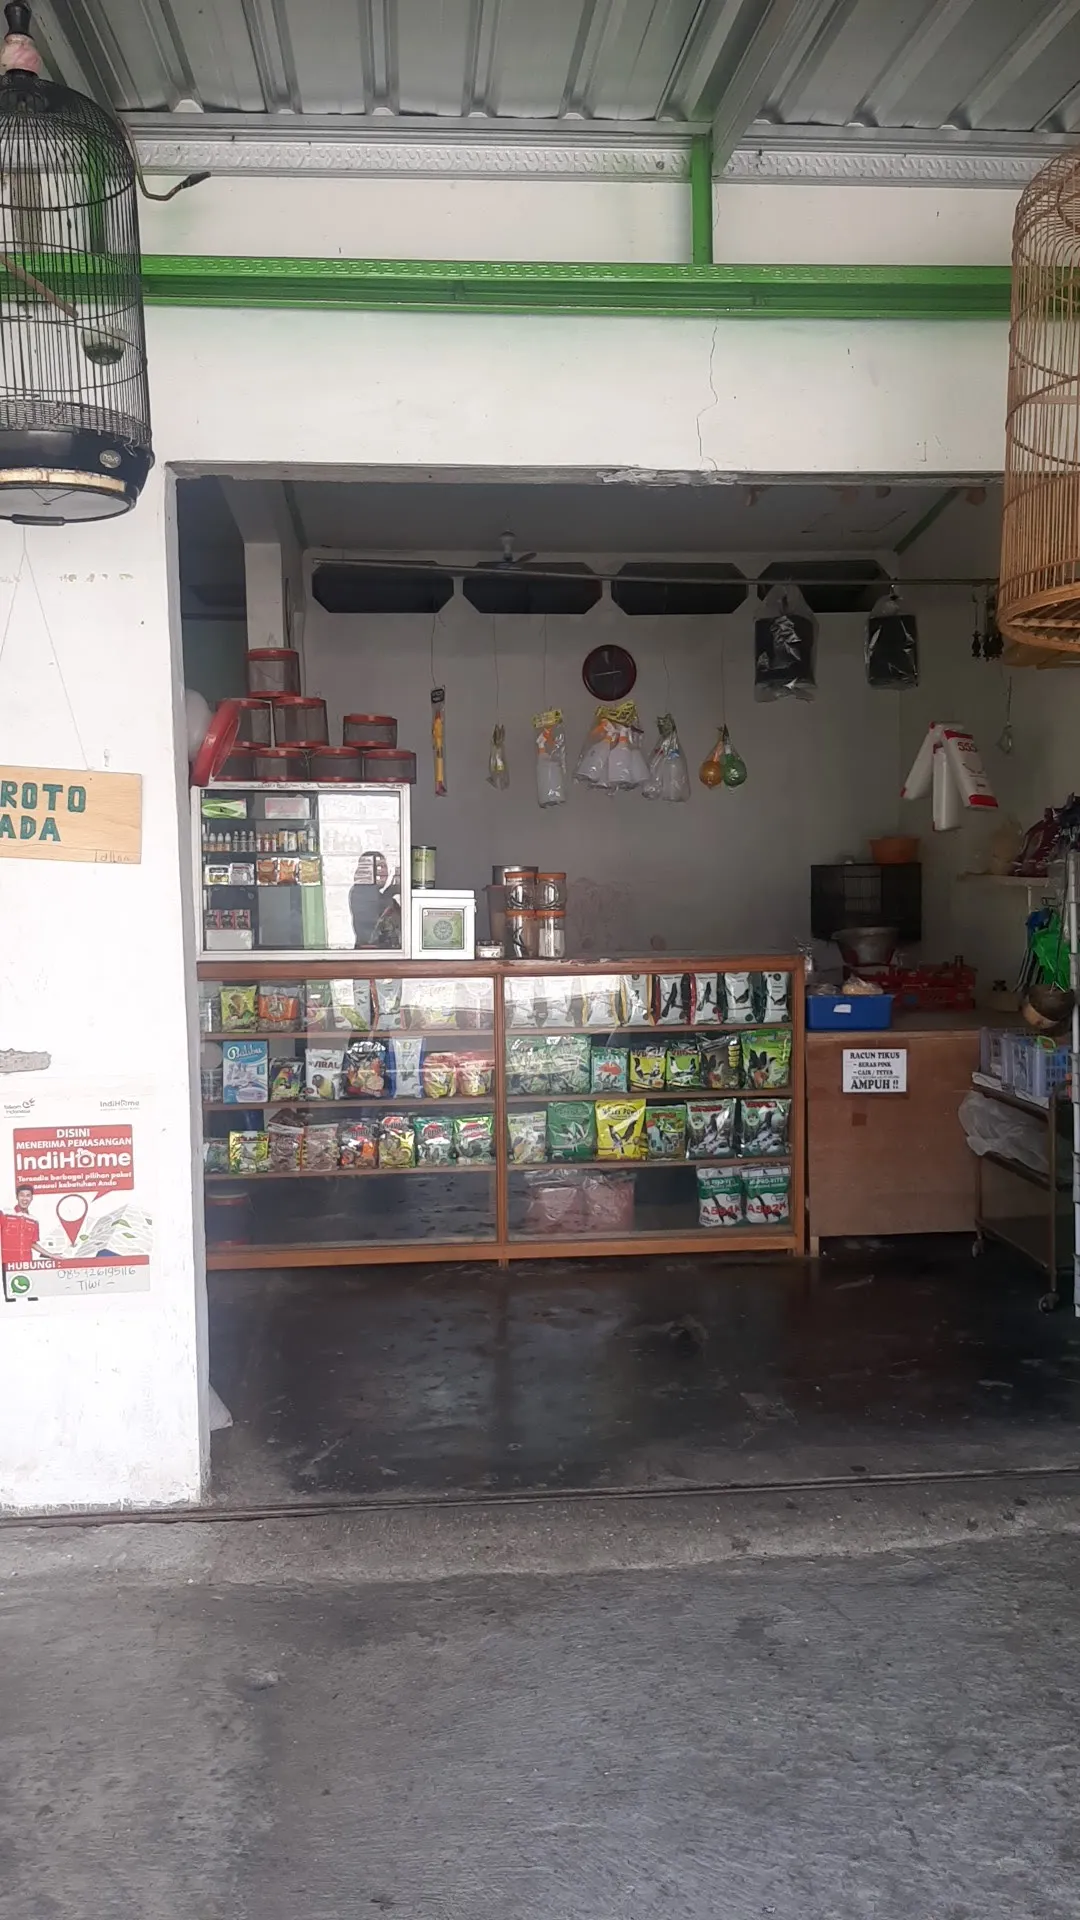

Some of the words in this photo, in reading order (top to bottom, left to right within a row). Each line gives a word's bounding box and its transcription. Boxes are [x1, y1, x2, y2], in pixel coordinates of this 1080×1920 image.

[851, 1079, 890, 1089] AMPUH
[56, 1128, 90, 1138] DISINI
[16, 1140, 66, 1149] MENERIMA
[68, 1137, 132, 1147] PEMASANGAN
[16, 1148, 131, 1170] IndiHome
[50, 1173, 84, 1182] berbagai
[85, 1172, 110, 1181] pilihan
[111, 1171, 132, 1180] paket
[58, 1180, 97, 1188] kebutuhan
[7, 1260, 56, 1270] HUBUNGI
